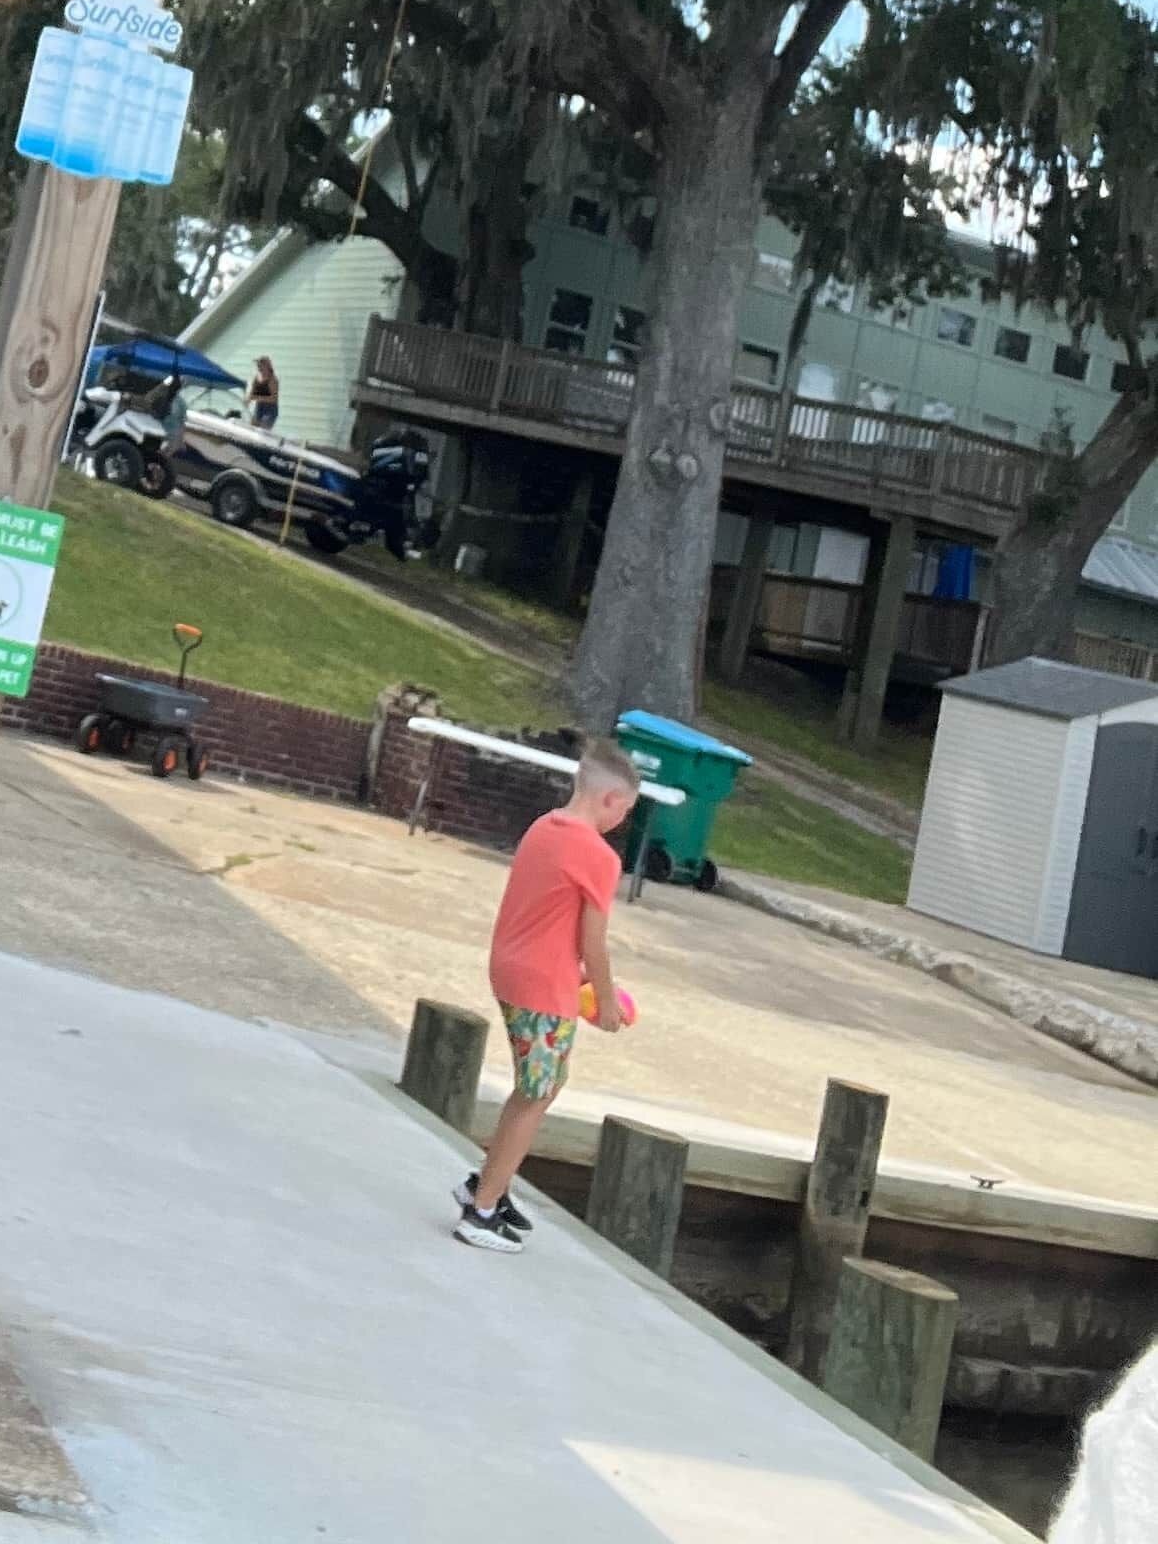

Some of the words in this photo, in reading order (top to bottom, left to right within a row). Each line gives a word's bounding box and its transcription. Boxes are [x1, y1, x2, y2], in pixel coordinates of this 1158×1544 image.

[39, 521, 59, 539] BE
[0, 529, 48, 555] LEASH
[11, 651, 28, 665] UP
